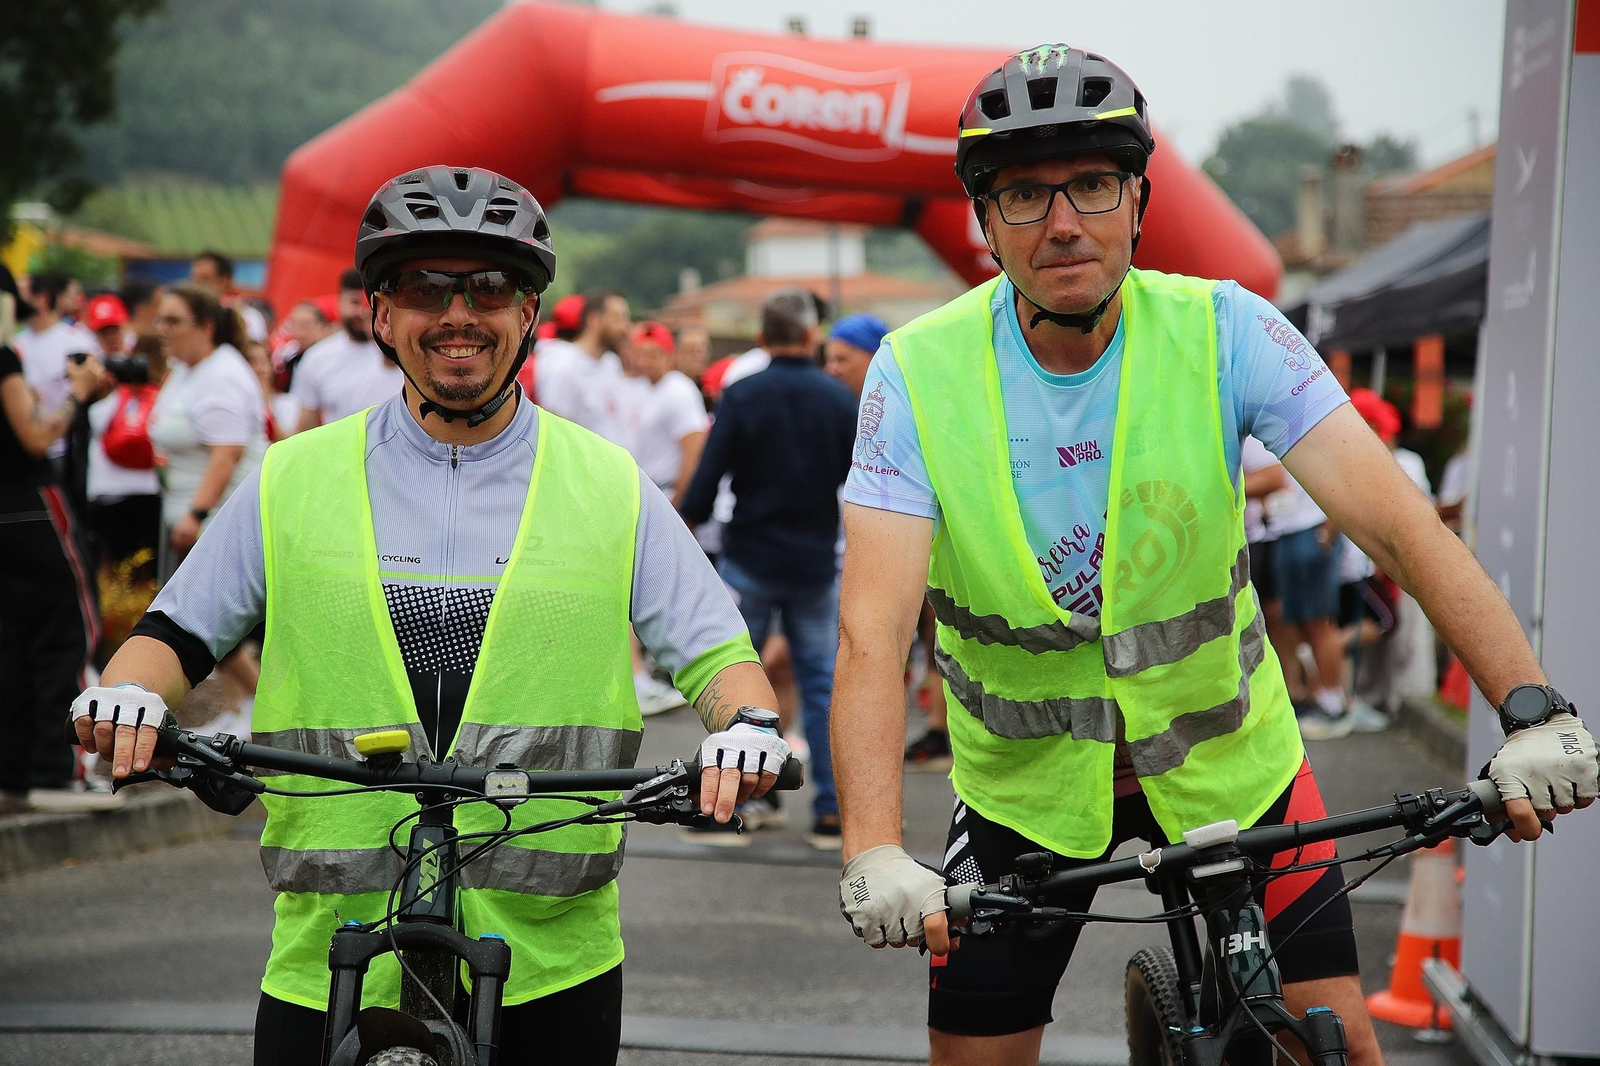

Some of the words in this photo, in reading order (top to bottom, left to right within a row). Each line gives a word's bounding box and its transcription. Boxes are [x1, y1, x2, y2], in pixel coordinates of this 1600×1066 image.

[1291, 369, 1323, 396] Concello
[1075, 440, 1097, 453] RUN
[863, 463, 873, 473] de
[875, 465, 900, 477] Leiro
[382, 554, 421, 564] CYCLING
[1037, 523, 1090, 584] reira
[1051, 532, 1105, 605] PULAR
[1556, 731, 1584, 755] SPIUK
[849, 875, 871, 908] SPIUK
[1220, 930, 1266, 958] BH
